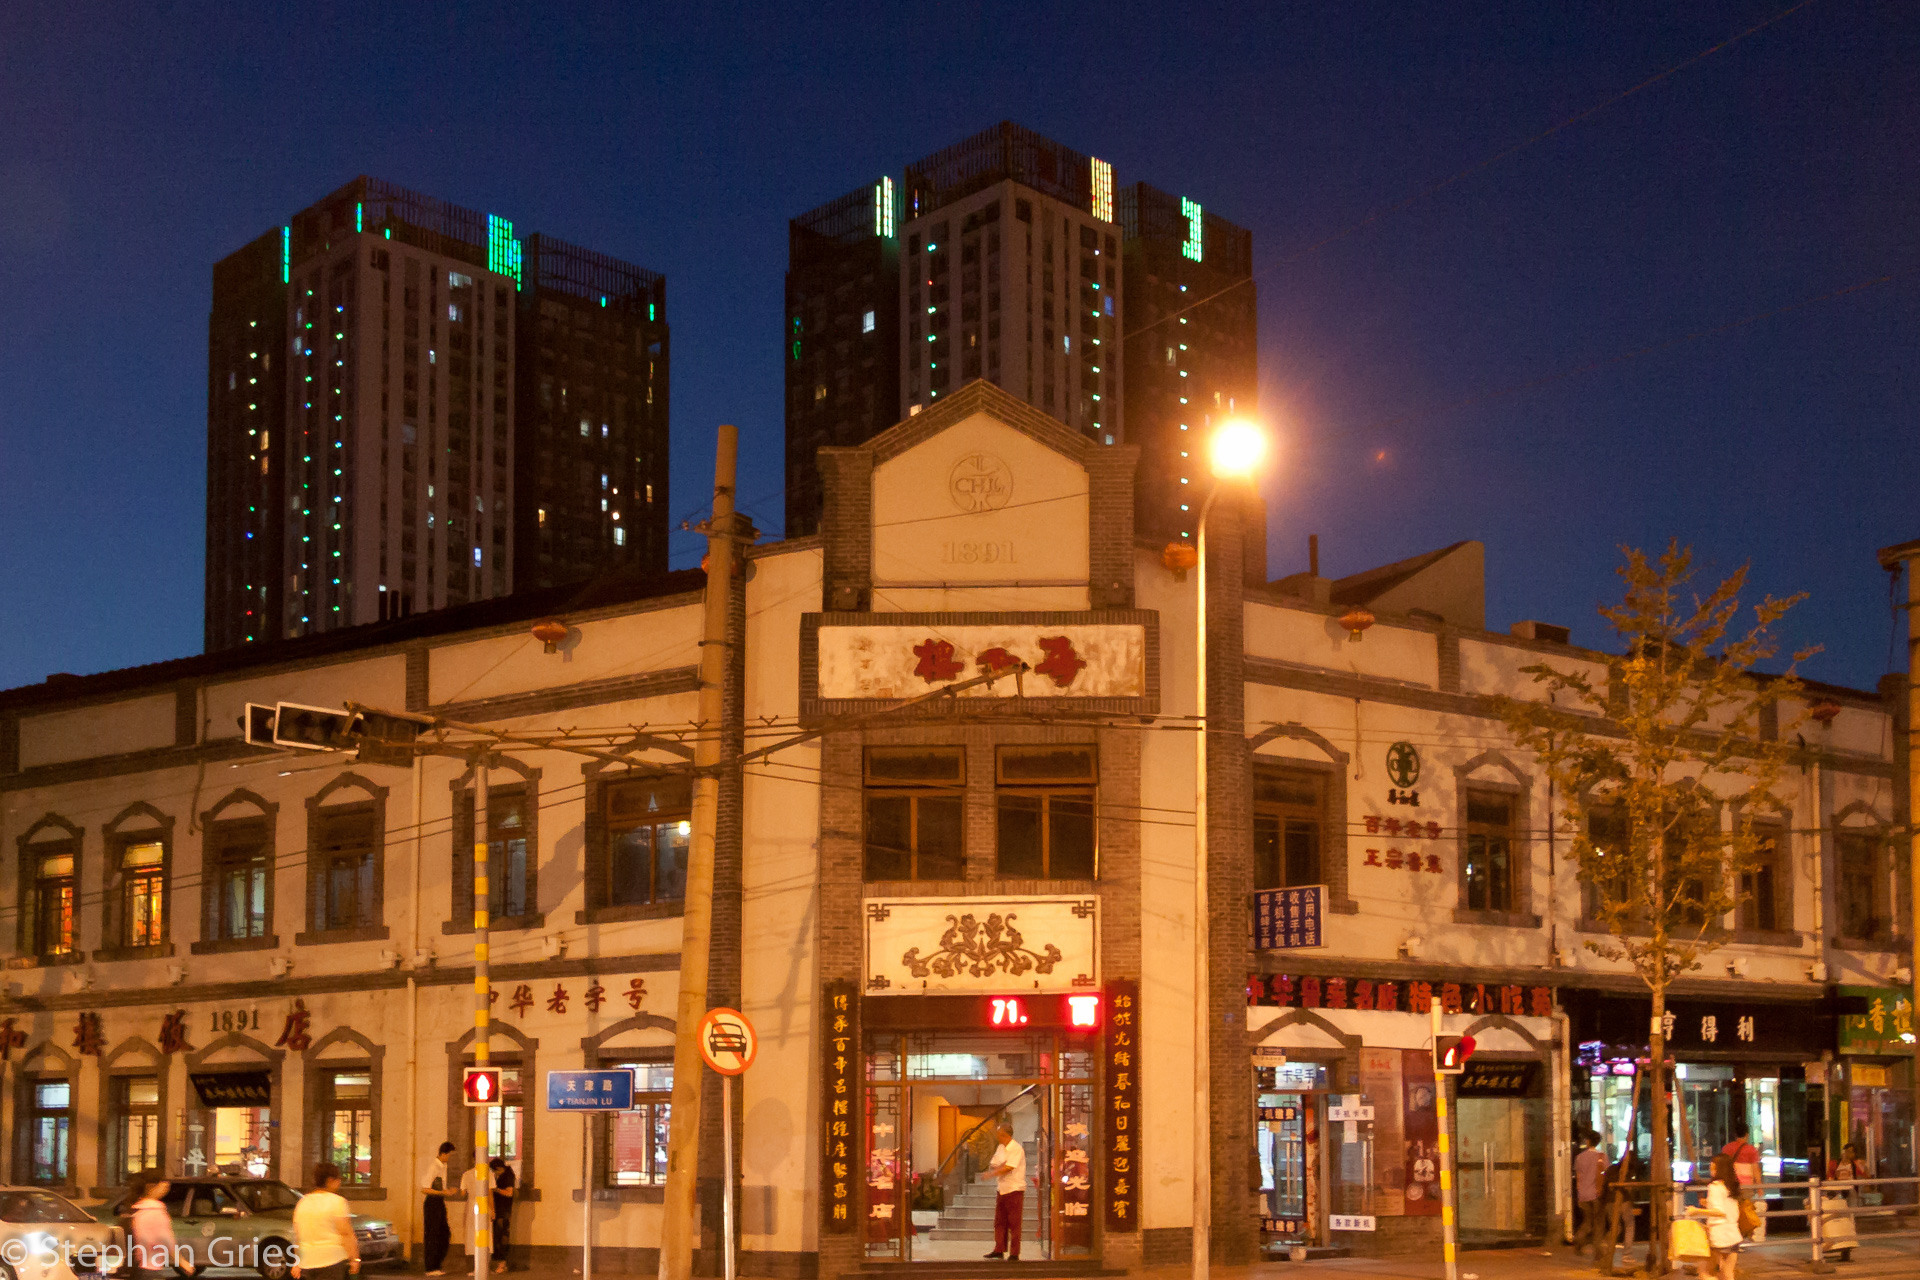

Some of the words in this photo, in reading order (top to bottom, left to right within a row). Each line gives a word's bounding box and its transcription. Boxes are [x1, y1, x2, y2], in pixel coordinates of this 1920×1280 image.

[942, 541, 1018, 564] 1891
[1275, 892, 1285, 947] 手机充值
[1304, 889, 1315, 945] 公用电话
[211, 1009, 260, 1032] 1891
[566, 1080, 613, 1092] 天津路
[566, 1097, 598, 1106] TIANJIN
[601, 1097, 613, 1106] LU
